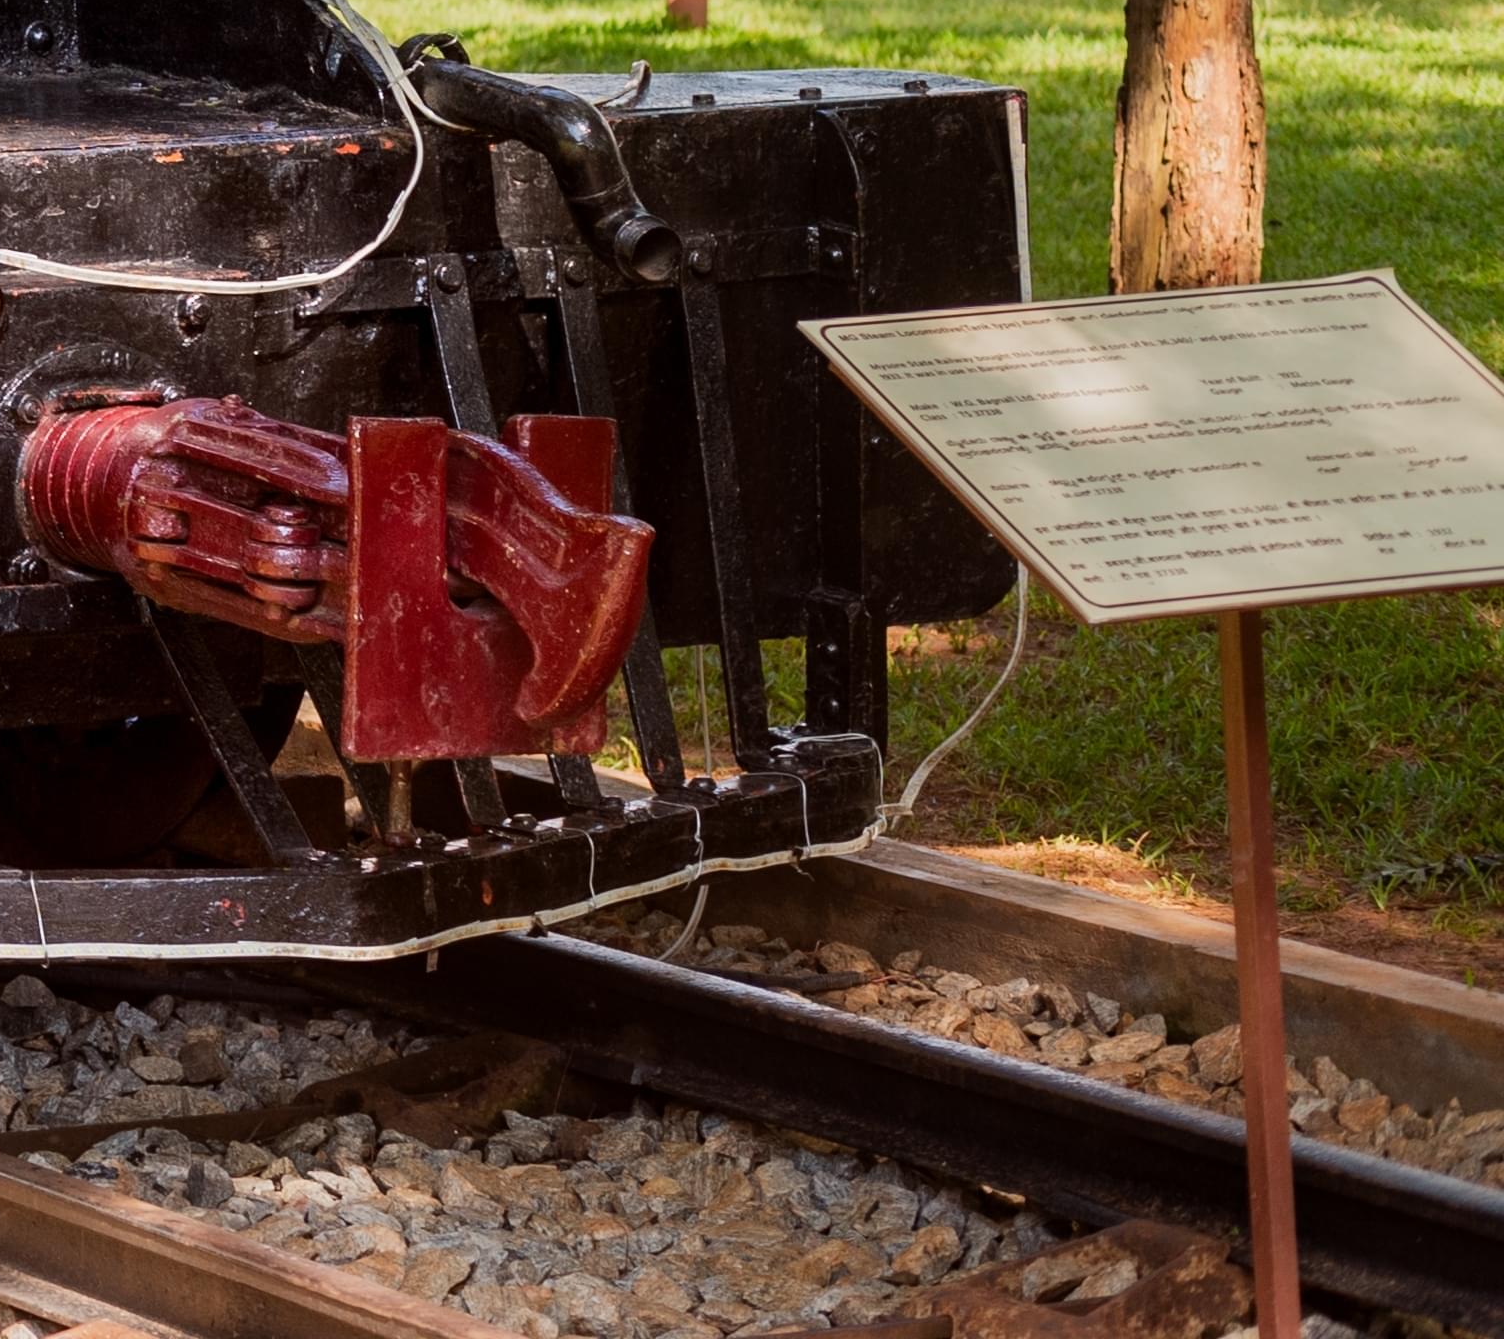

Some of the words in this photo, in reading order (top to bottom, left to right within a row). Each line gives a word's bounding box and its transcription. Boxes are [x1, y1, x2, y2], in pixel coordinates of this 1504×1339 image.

[838, 333, 859, 342] MG
[859, 332, 896, 341] Steam
[869, 362, 907, 372] Mysore
[907, 360, 934, 368] State
[934, 357, 973, 365] Railway
[974, 353, 1011, 362] bought
[1031, 347, 1086, 357] locomotive
[1200, 334, 1218, 343] and
[1237, 332, 1256, 340] this
[1289, 327, 1319, 335] tracks
[1330, 324, 1347, 332] the
[1350, 323, 1368, 331] year
[948, 368, 965, 376] use
[977, 363, 1027, 373] Bangalore
[1030, 360, 1048, 369] and
[1321, 378, 1354, 386] Gauge
[909, 403, 939, 411] Make
[976, 395, 1016, 406] Bagnall
[1037, 390, 1080, 401] Stafford
[920, 414, 947, 422] Class
